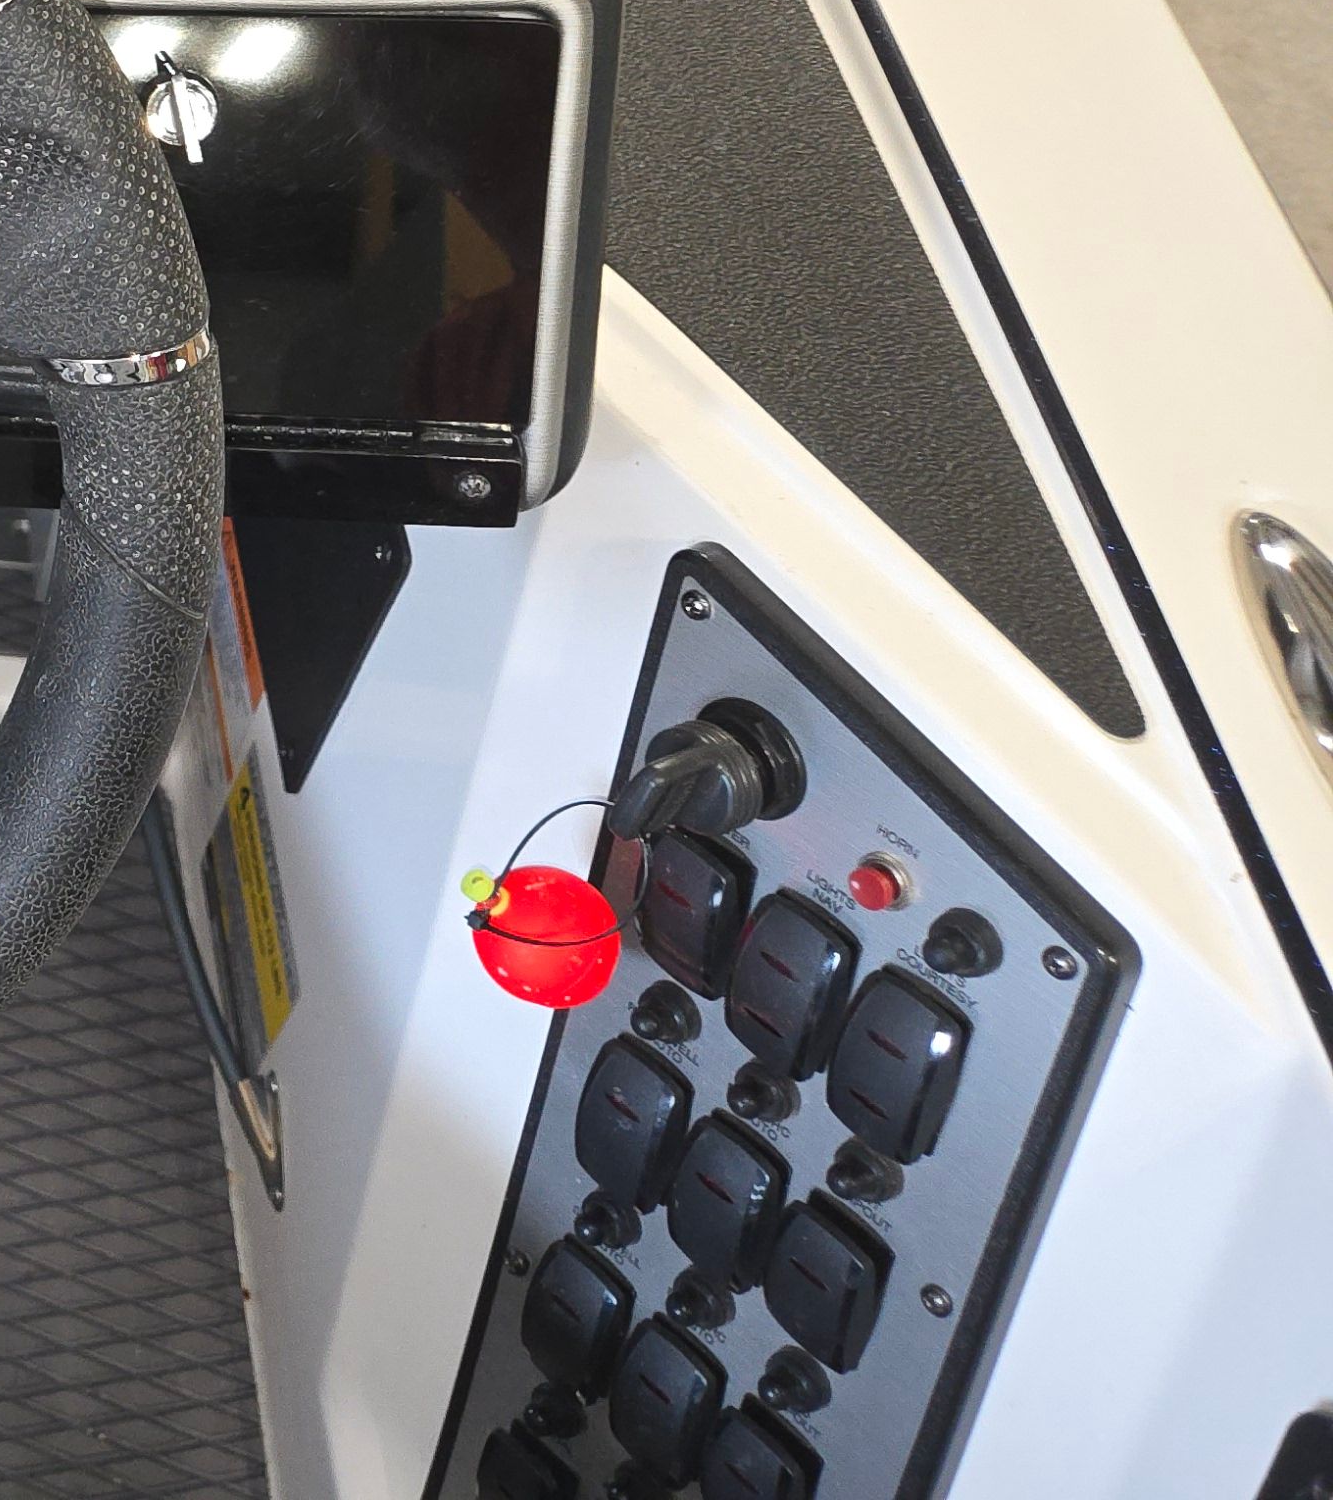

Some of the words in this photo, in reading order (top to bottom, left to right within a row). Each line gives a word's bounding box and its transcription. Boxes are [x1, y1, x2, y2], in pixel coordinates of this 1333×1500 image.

[876, 823, 920, 859] HORN
[806, 868, 856, 910] LIGHTS
[812, 888, 843, 914] NAV
[896, 947, 980, 1010] COURTESY
